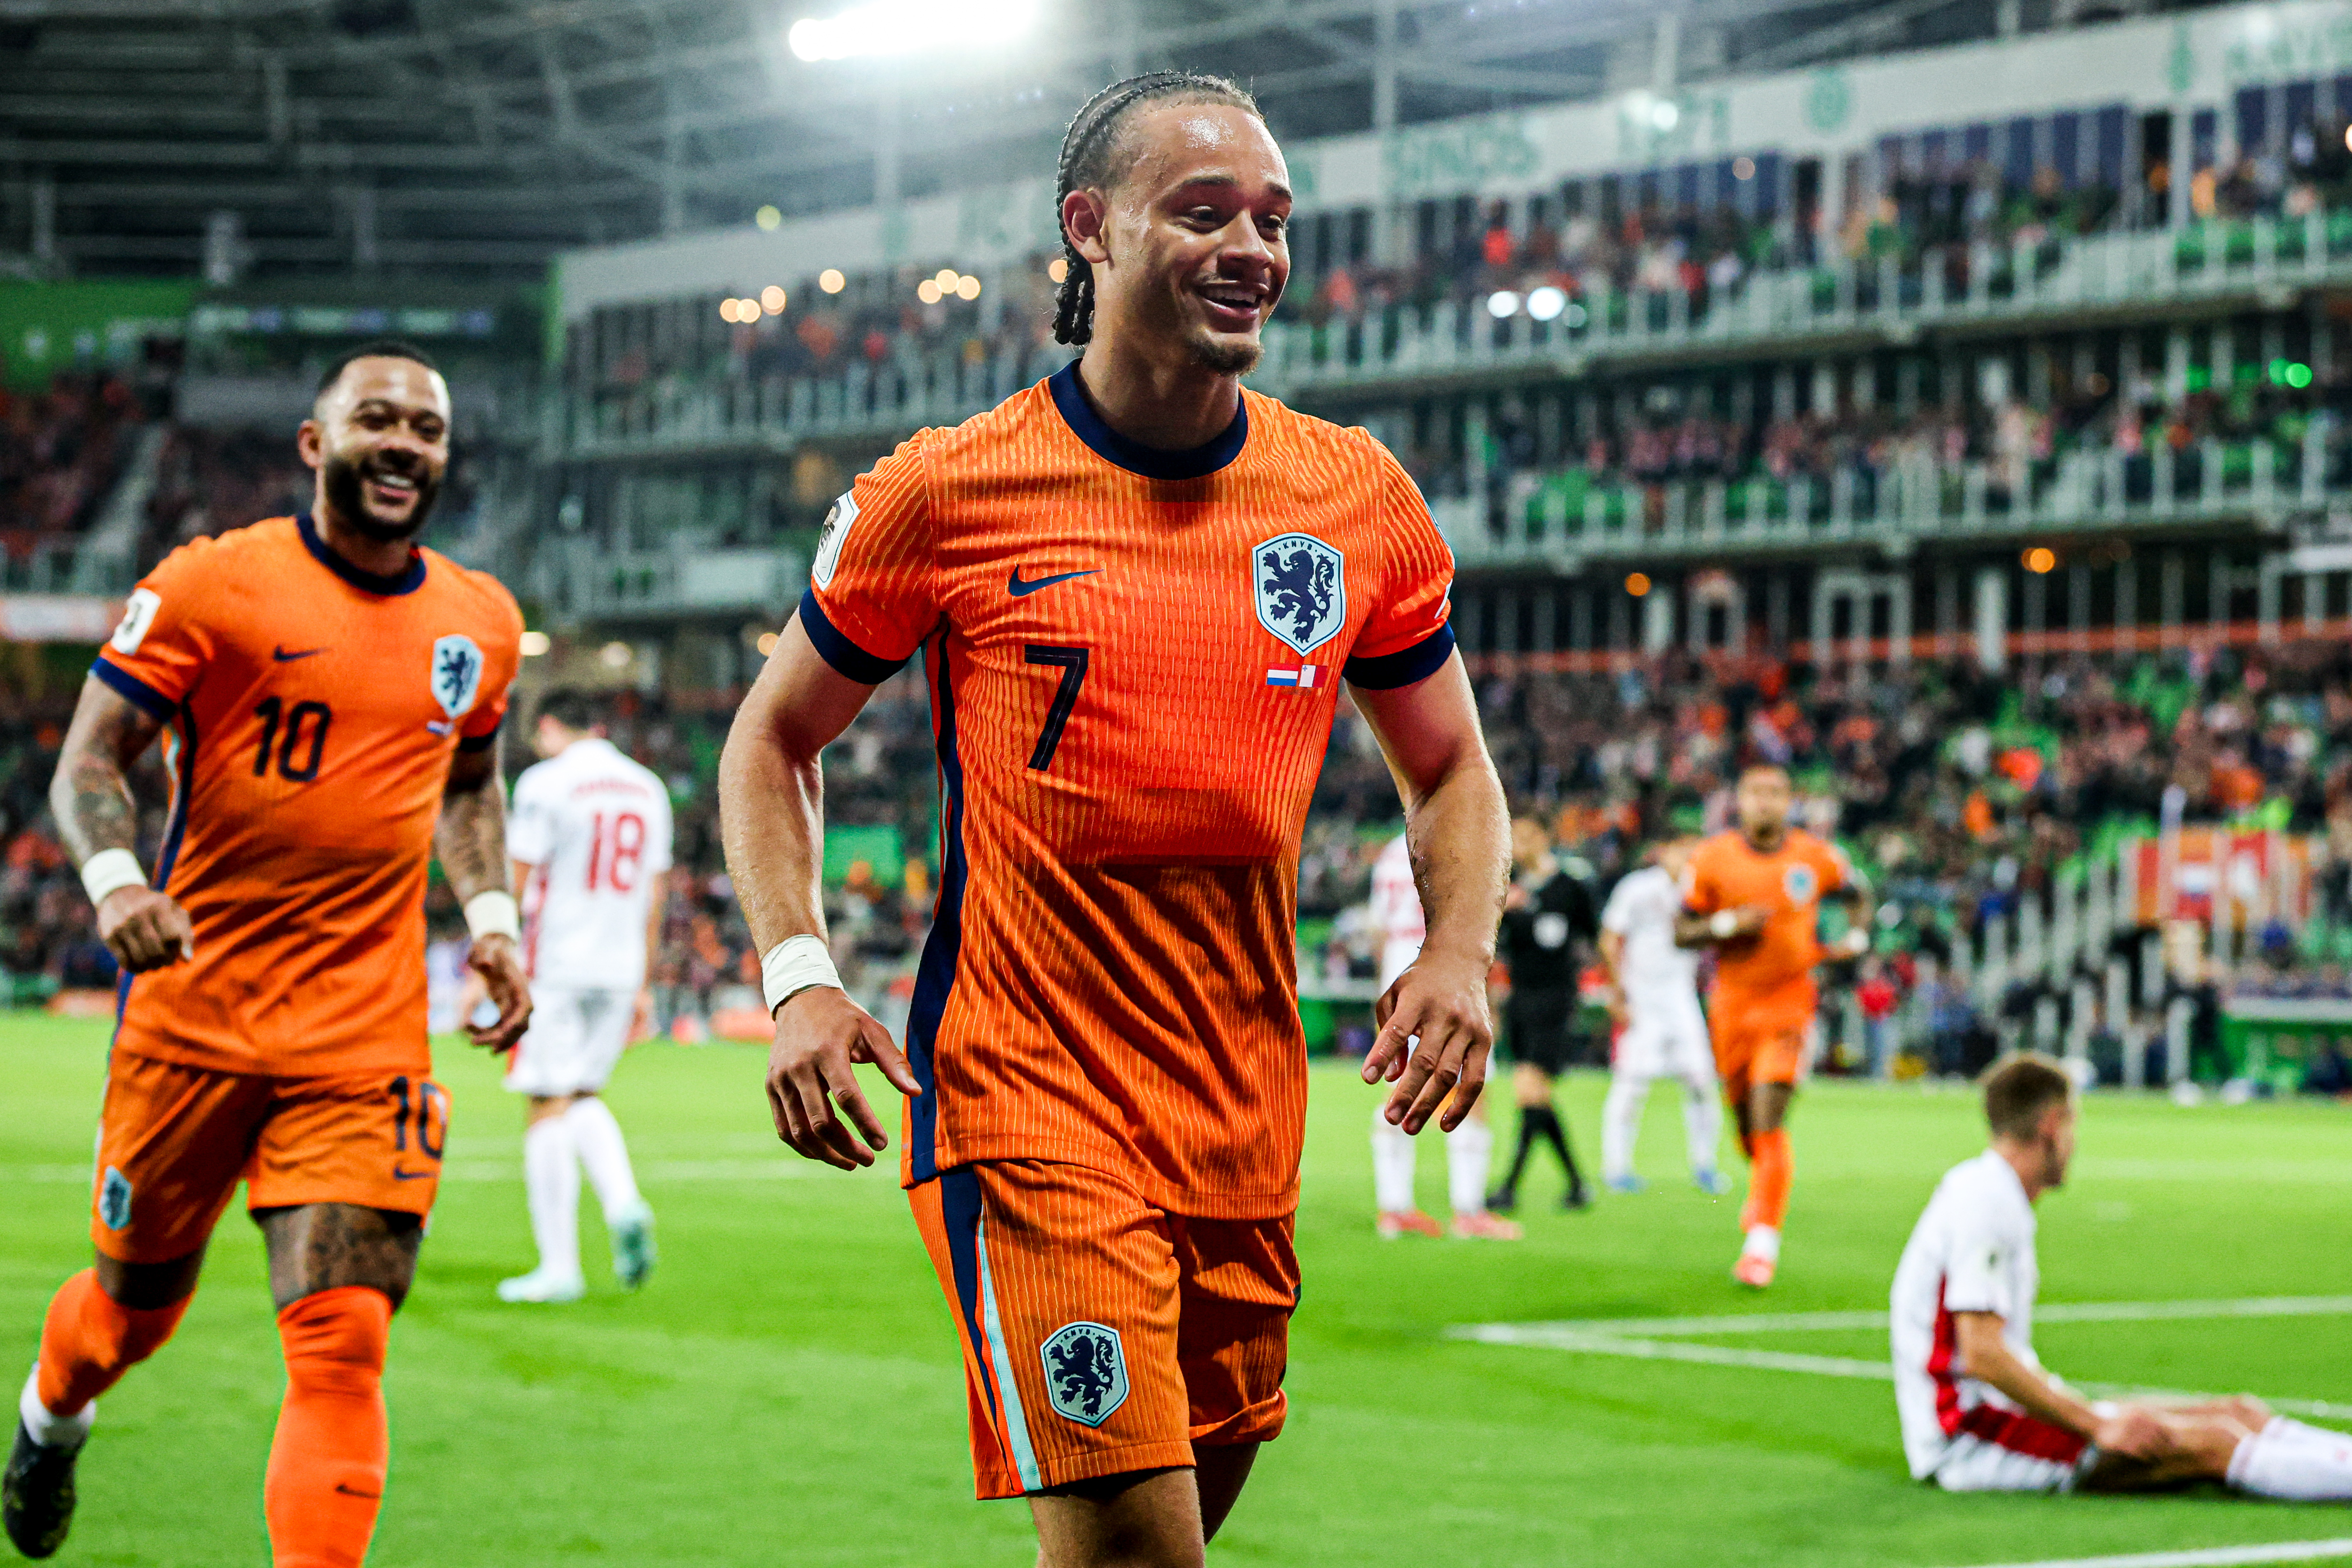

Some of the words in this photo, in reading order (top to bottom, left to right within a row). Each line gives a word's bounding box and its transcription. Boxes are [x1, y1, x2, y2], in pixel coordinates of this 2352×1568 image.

[1282, 540, 1312, 550] KNVB
[254, 695, 333, 782] 10
[1024, 644, 1089, 771] 7
[584, 811, 646, 893] 18
[388, 1075, 448, 1162] 10
[1063, 1328, 1091, 1340] KNVB
